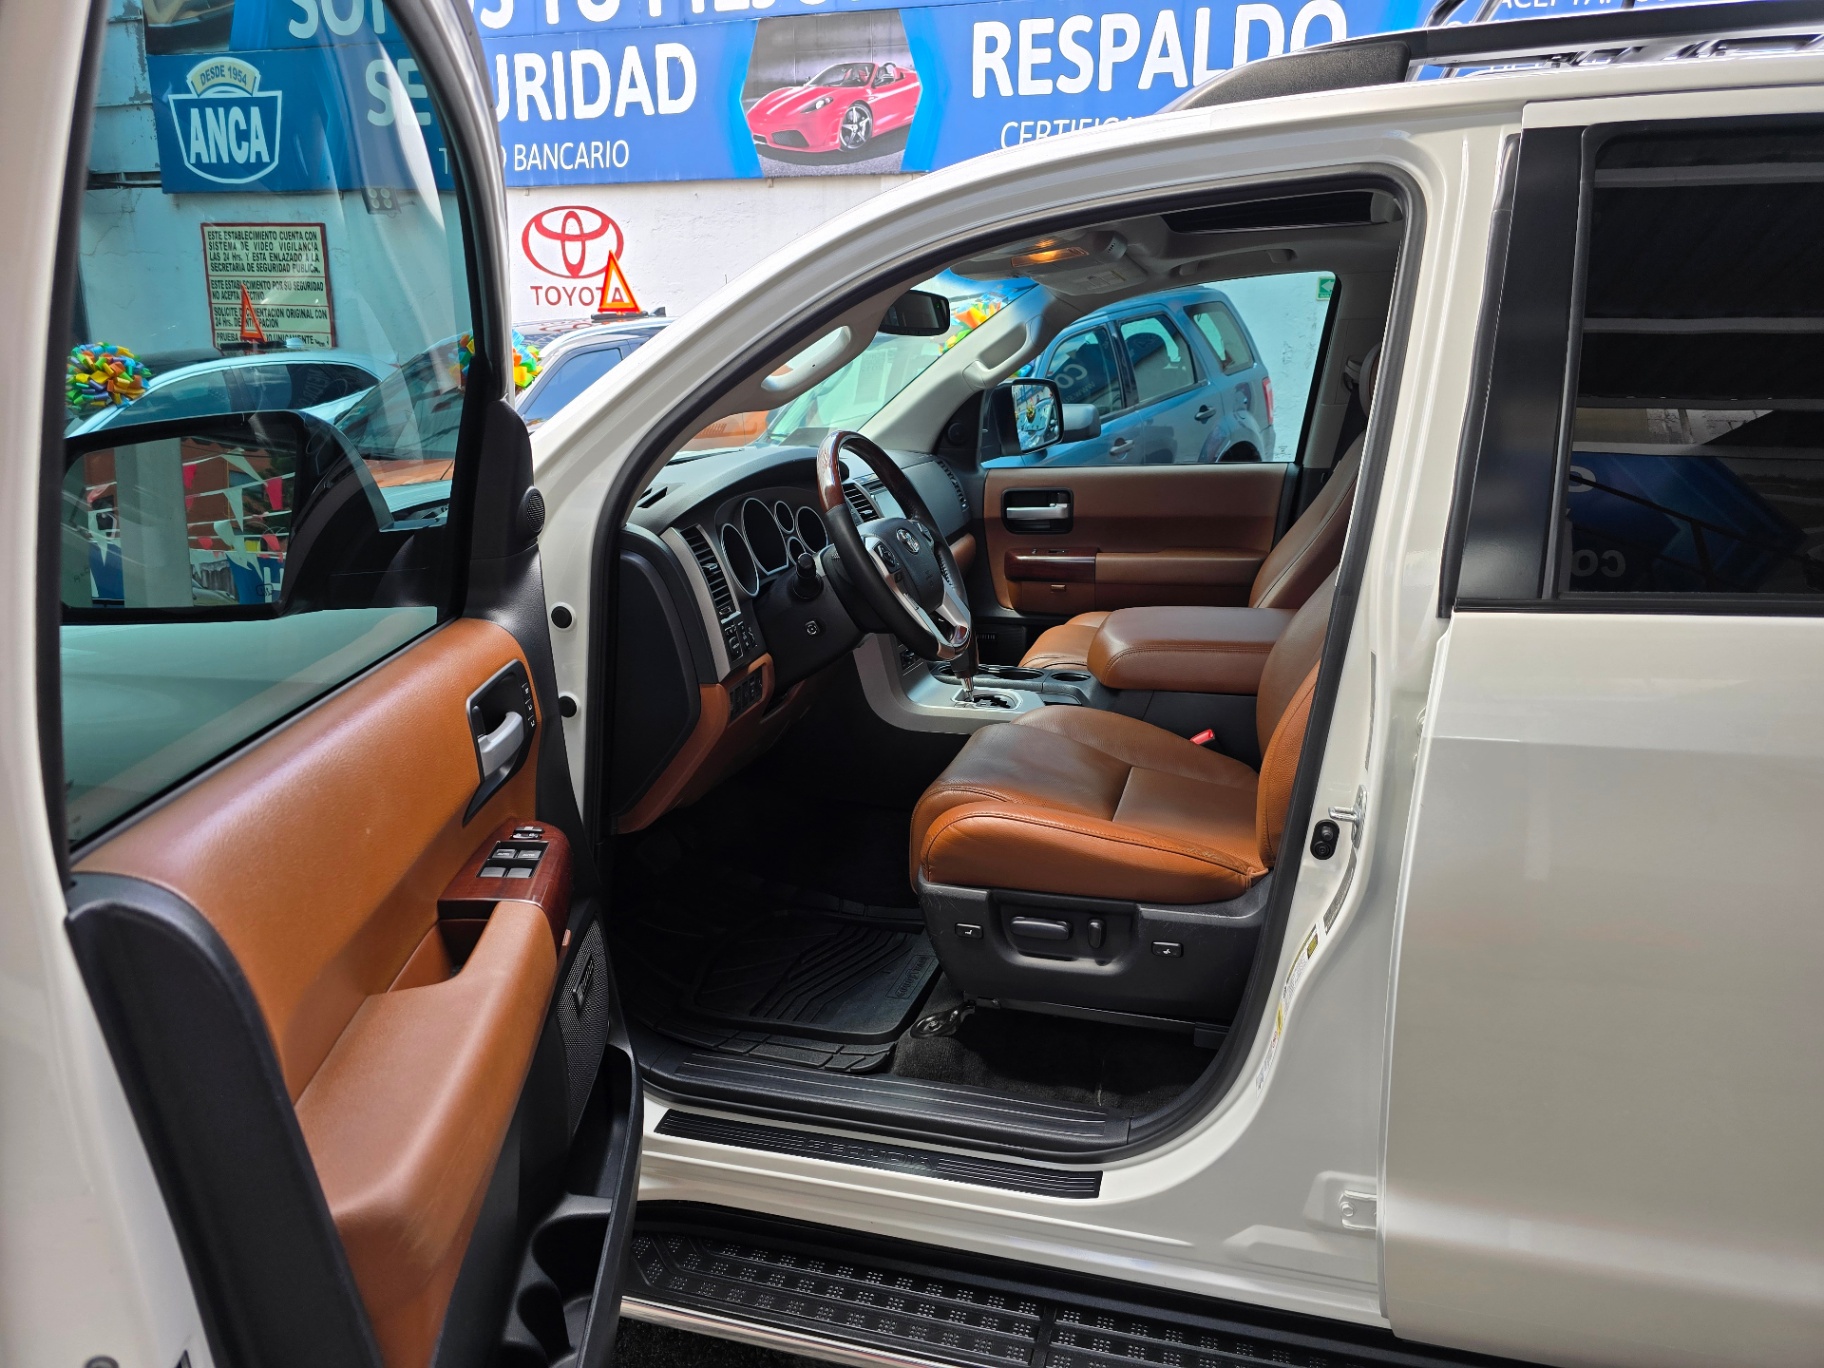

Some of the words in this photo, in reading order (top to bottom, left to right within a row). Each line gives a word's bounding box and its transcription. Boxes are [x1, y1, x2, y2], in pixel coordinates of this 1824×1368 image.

[200, 65, 225, 86] DESDE
[228, 66, 247, 86] 1954
[190, 106, 270, 164] ANCA
[514, 140, 629, 172] BANCARIO
[208, 231, 222, 240] ESTE
[224, 231, 277, 241] ESTABLECIMIENTO
[280, 231, 303, 241] CUENTA
[305, 231, 317, 241] CON
[209, 241, 237, 251] SISTEMA
[254, 241, 273, 251] VIDEO
[279, 242, 319, 252] VIGILANCIA
[210, 252, 221, 261] LAS
[252, 252, 267, 262] ESTA
[269, 252, 302, 262] ENLAZADO
[211, 263, 245, 272] SECRETARIA
[247, 263, 255, 272] DE
[256, 263, 290, 273] SEGURIDAD
[211, 280, 224, 289] ESTE
[286, 308, 314, 319] ORIGINAL
[315, 309, 328, 320] CON
